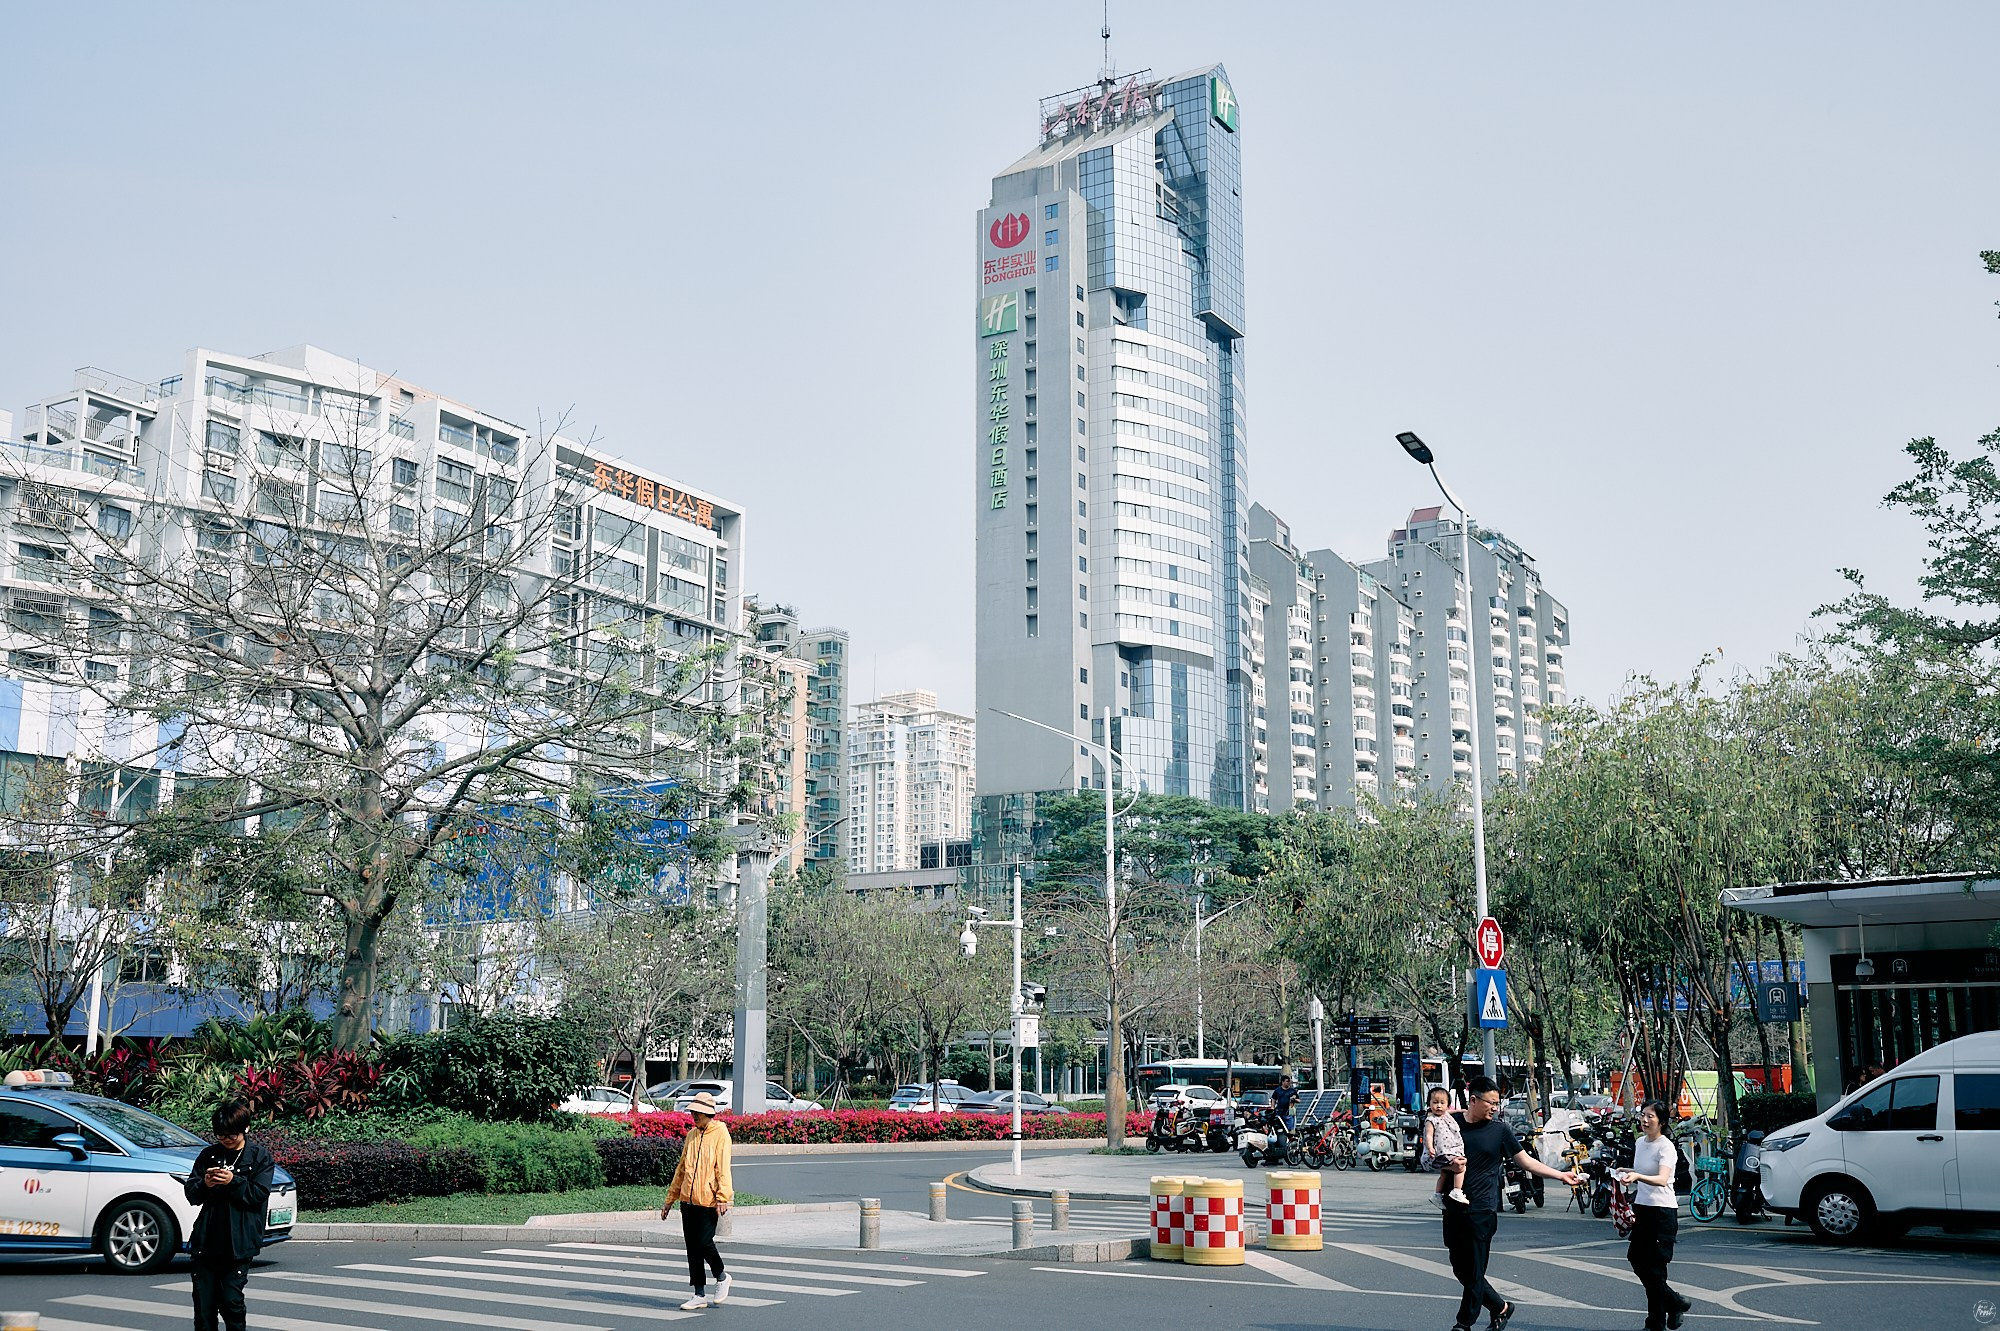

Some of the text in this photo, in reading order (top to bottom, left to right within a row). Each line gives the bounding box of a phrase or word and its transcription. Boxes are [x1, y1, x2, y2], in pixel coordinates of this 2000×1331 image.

[984, 250, 1036, 275] 东华实业
[984, 265, 1036, 285] DONGHUA
[988, 338, 1009, 511] 深圳东华假日酒店
[594, 461, 714, 530] 东华假日公寓
[1481, 926, 1499, 960] 停
[1769, 1006, 1787, 1015] 地铁
[18, 1220, 60, 1236] 12328
